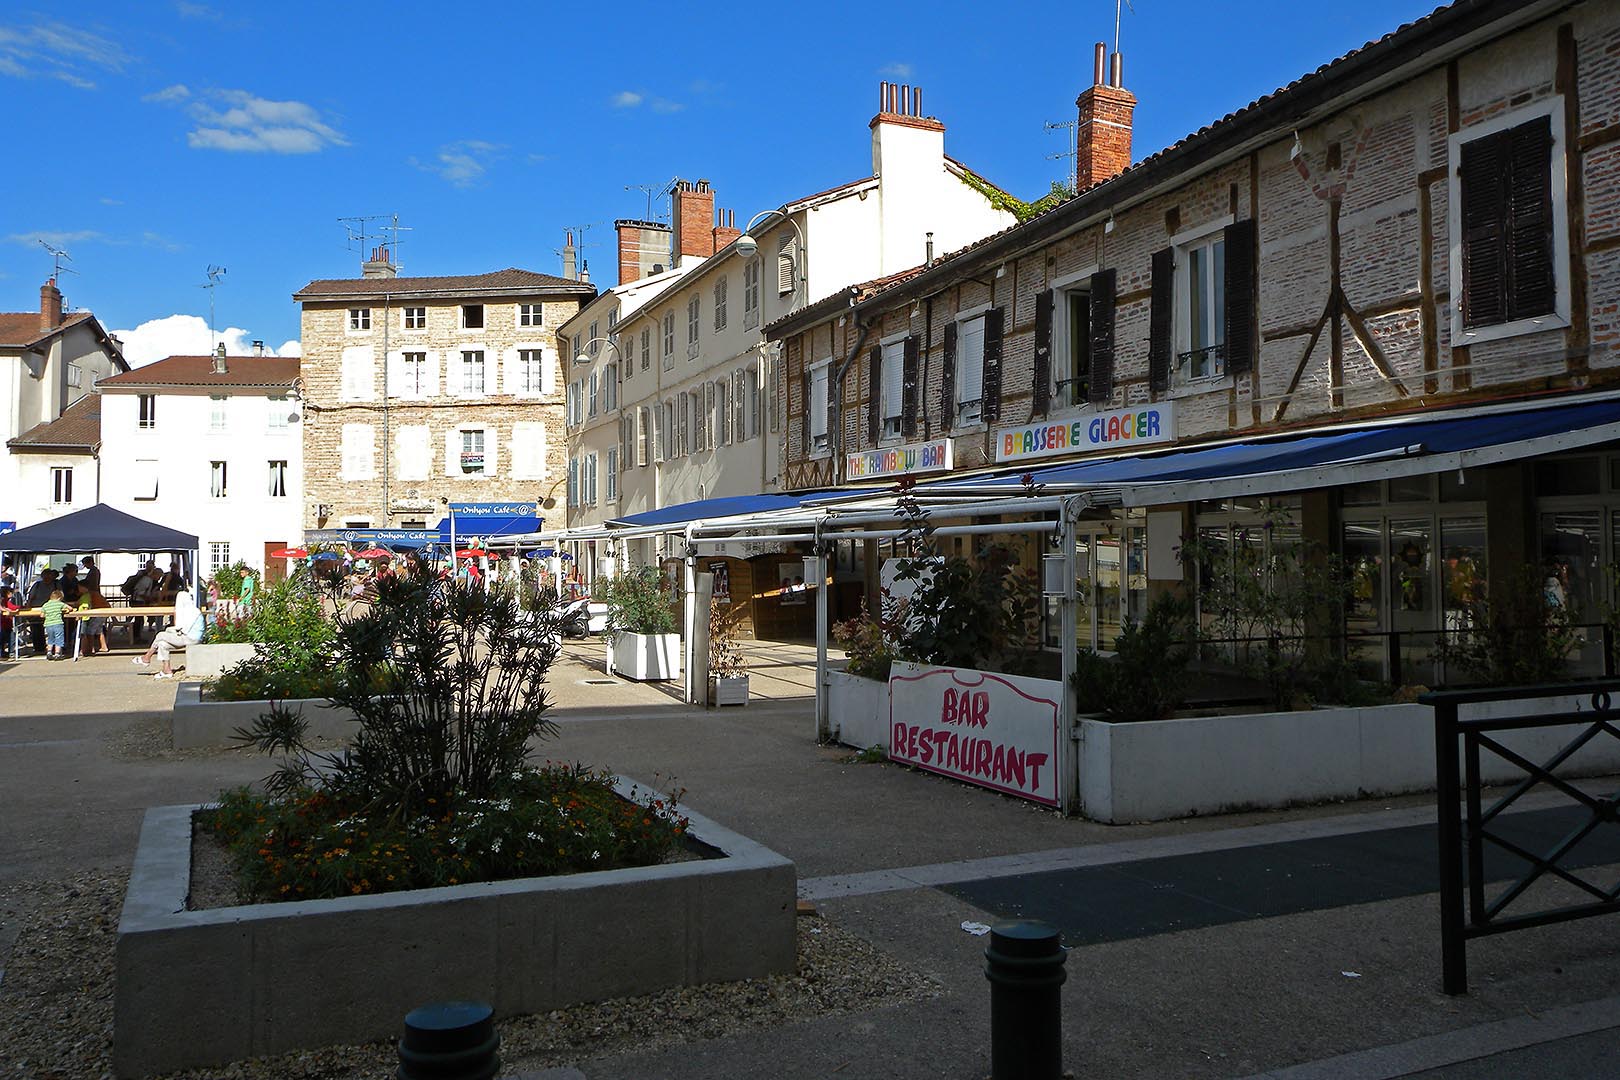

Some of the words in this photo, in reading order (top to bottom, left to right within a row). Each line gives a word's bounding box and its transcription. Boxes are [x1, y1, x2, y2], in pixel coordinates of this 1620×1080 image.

[1004, 422, 1080, 456] BRASSERIE
[1089, 410, 1160, 443] GLACIER
[849, 457, 865, 475] THE
[868, 449, 916, 474] RAINBOW
[922, 445, 944, 467] BAR
[942, 687, 989, 729] BAR
[894, 722, 1048, 792] RESTAURANT
